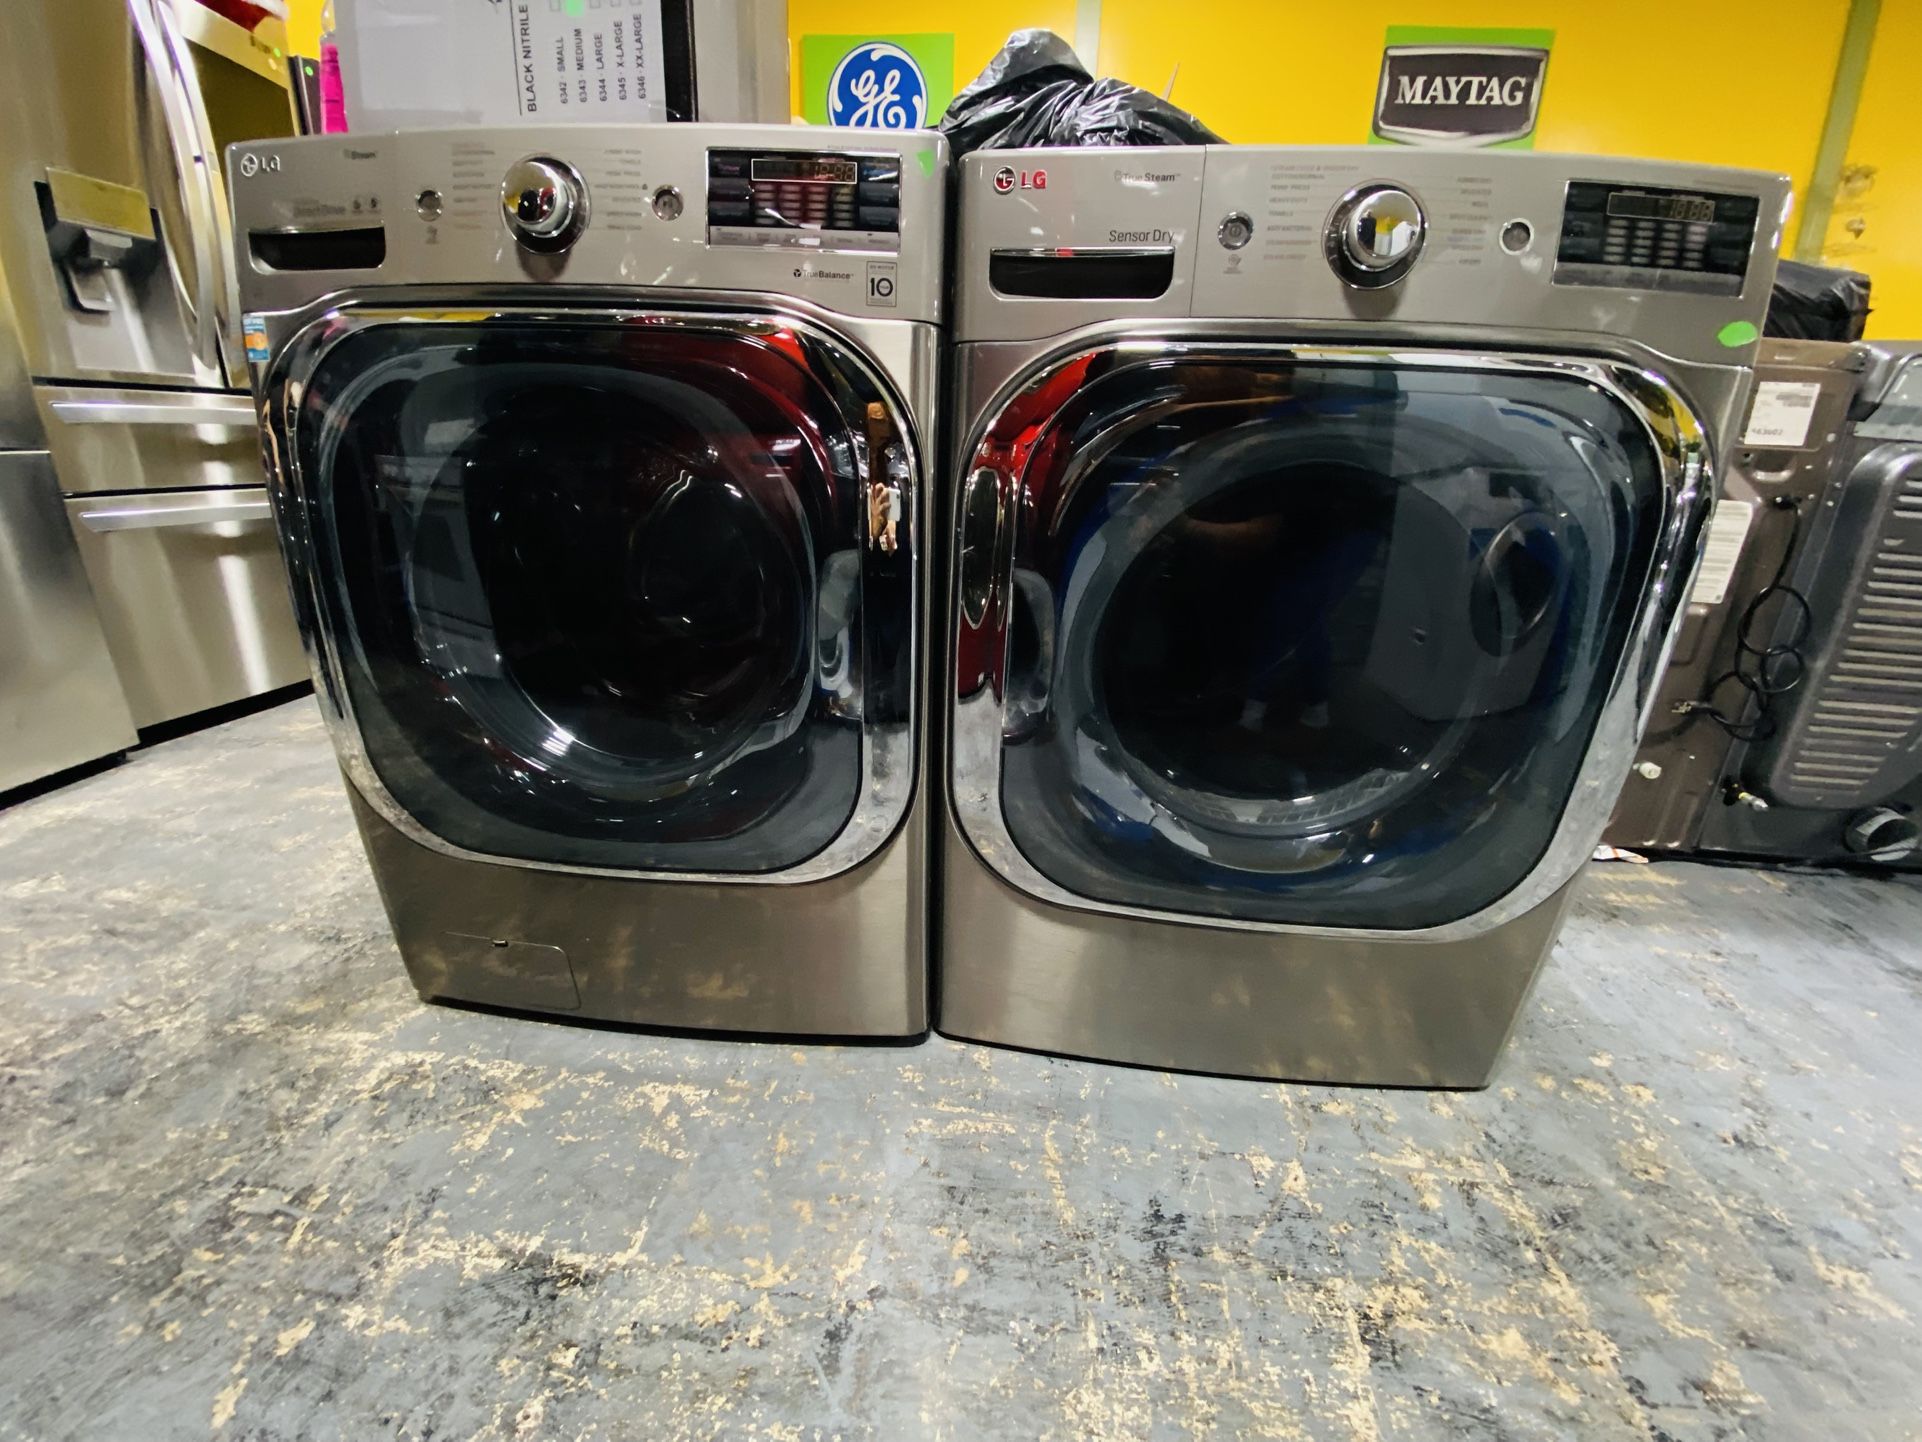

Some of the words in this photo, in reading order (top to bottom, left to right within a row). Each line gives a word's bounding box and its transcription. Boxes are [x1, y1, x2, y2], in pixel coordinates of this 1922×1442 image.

[518, 4, 532, 59] NITRILE
[613, 20, 625, 68] X-LARGE
[633, 13, 644, 69] XX-LARGE
[555, 36, 565, 72] SMALL
[574, 28, 584, 71] MEDIUM
[594, 33, 604, 70] LARGE
[523, 63, 537, 112] BLACK
[560, 81, 568, 104] 6342
[579, 79, 587, 103] 6343
[599, 78, 607, 102] 6344
[617, 76, 627, 100] 6345
[638, 75, 646, 99] 6346
[1394, 75, 1526, 107] MAYTAG
[1020, 169, 1048, 190] LG
[1109, 229, 1151, 243] Sensor
[1152, 229, 1175, 244] Dry
[870, 277, 894, 298] 10
